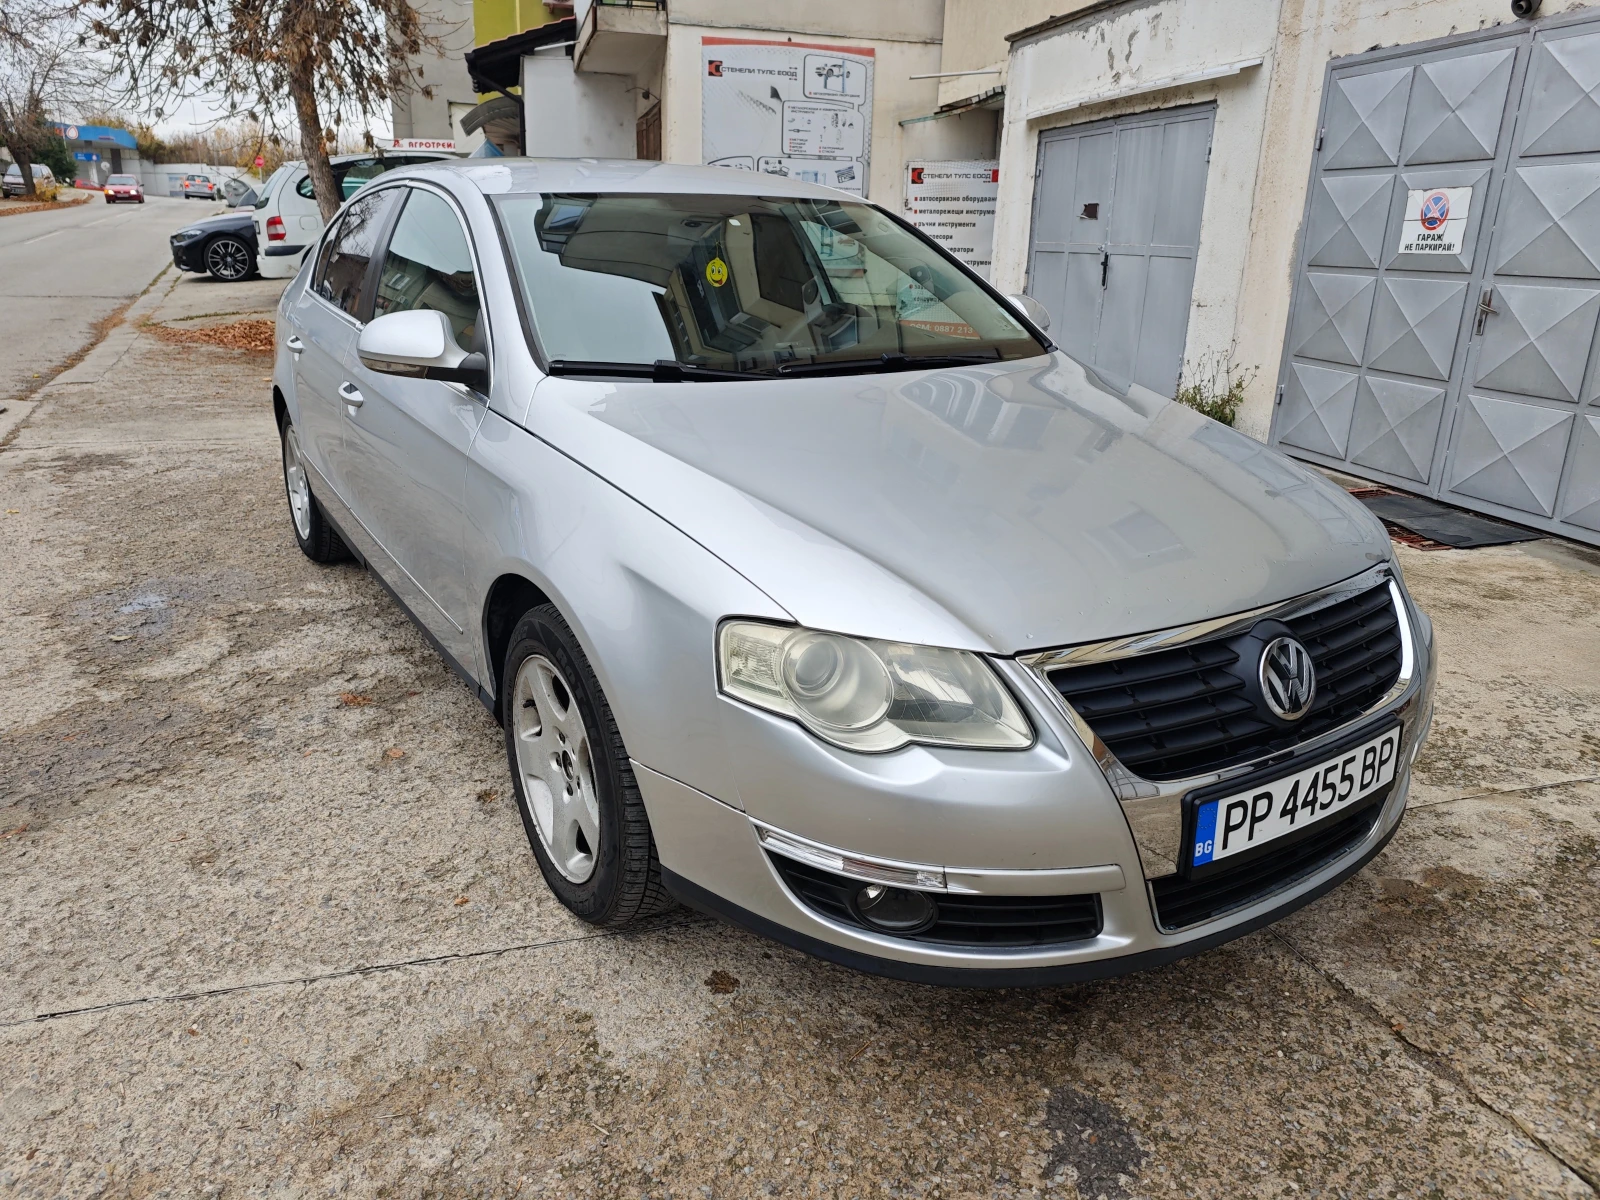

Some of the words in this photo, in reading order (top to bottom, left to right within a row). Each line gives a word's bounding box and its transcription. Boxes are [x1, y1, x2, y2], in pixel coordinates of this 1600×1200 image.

[721, 66, 756, 74] СТЕНЕЛИ
[757, 68, 776, 76] ТУЛС
[777, 70, 798, 78] ЕООД
[918, 195, 960, 203] автосервизно
[918, 221, 936, 229] ръчни
[1417, 233, 1444, 242] ГАРАЖ
[1404, 243, 1414, 251] НЕ
[1415, 242, 1455, 252] ПАРКИРАЙ!
[934, 325, 954, 333] 0887
[957, 326, 973, 334] 213
[1222, 790, 1273, 851] PP
[1279, 754, 1357, 826] 4455
[1359, 735, 1394, 793] BP
[1195, 840, 1213, 857] BG
